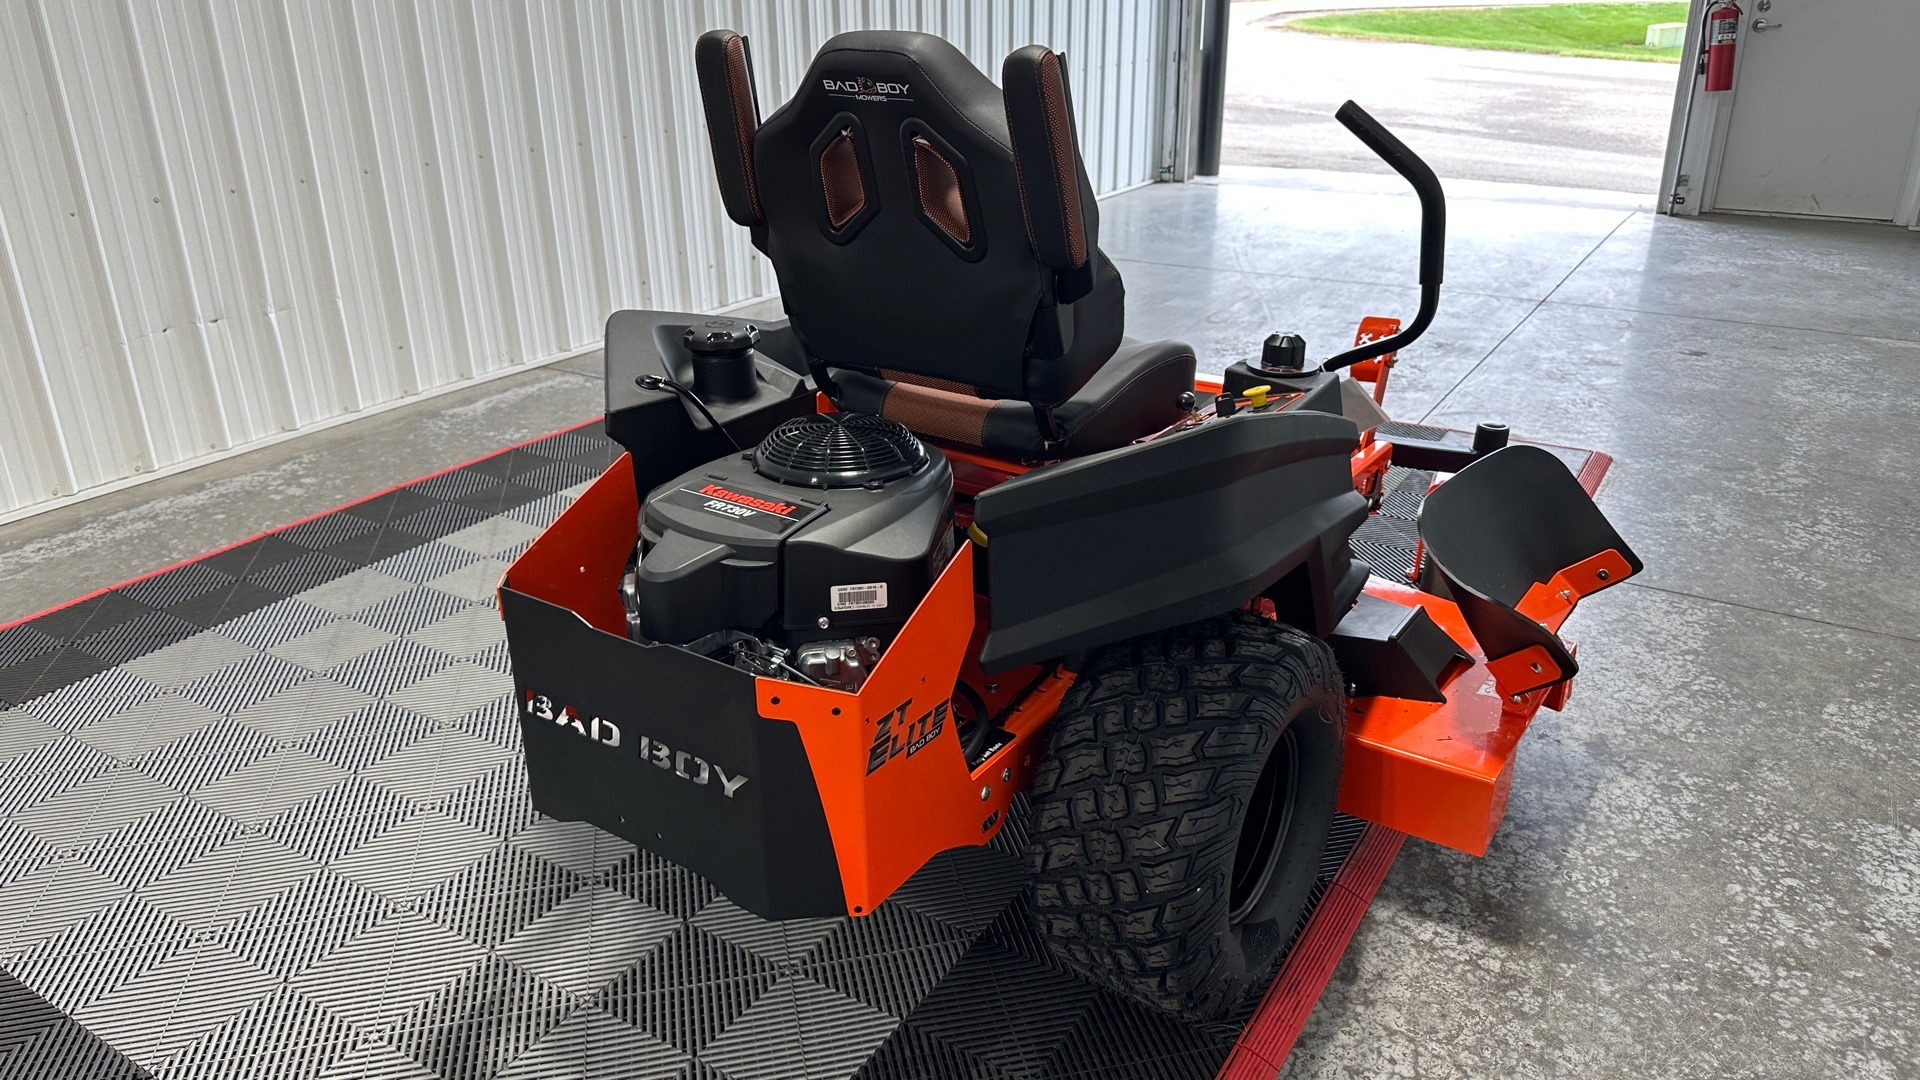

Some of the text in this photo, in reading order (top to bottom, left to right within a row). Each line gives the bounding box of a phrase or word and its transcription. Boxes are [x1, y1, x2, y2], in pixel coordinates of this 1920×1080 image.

[823, 79, 910, 95] BAD BOY
[855, 94, 887, 102] MOWERS
[699, 484, 797, 515] Kawasaki
[703, 500, 757, 517] FR730V
[874, 697, 913, 743] ZT
[525, 689, 749, 798] BAD BOY
[866, 697, 950, 777] ELITE
[909, 726, 941, 754] BAD BOY
